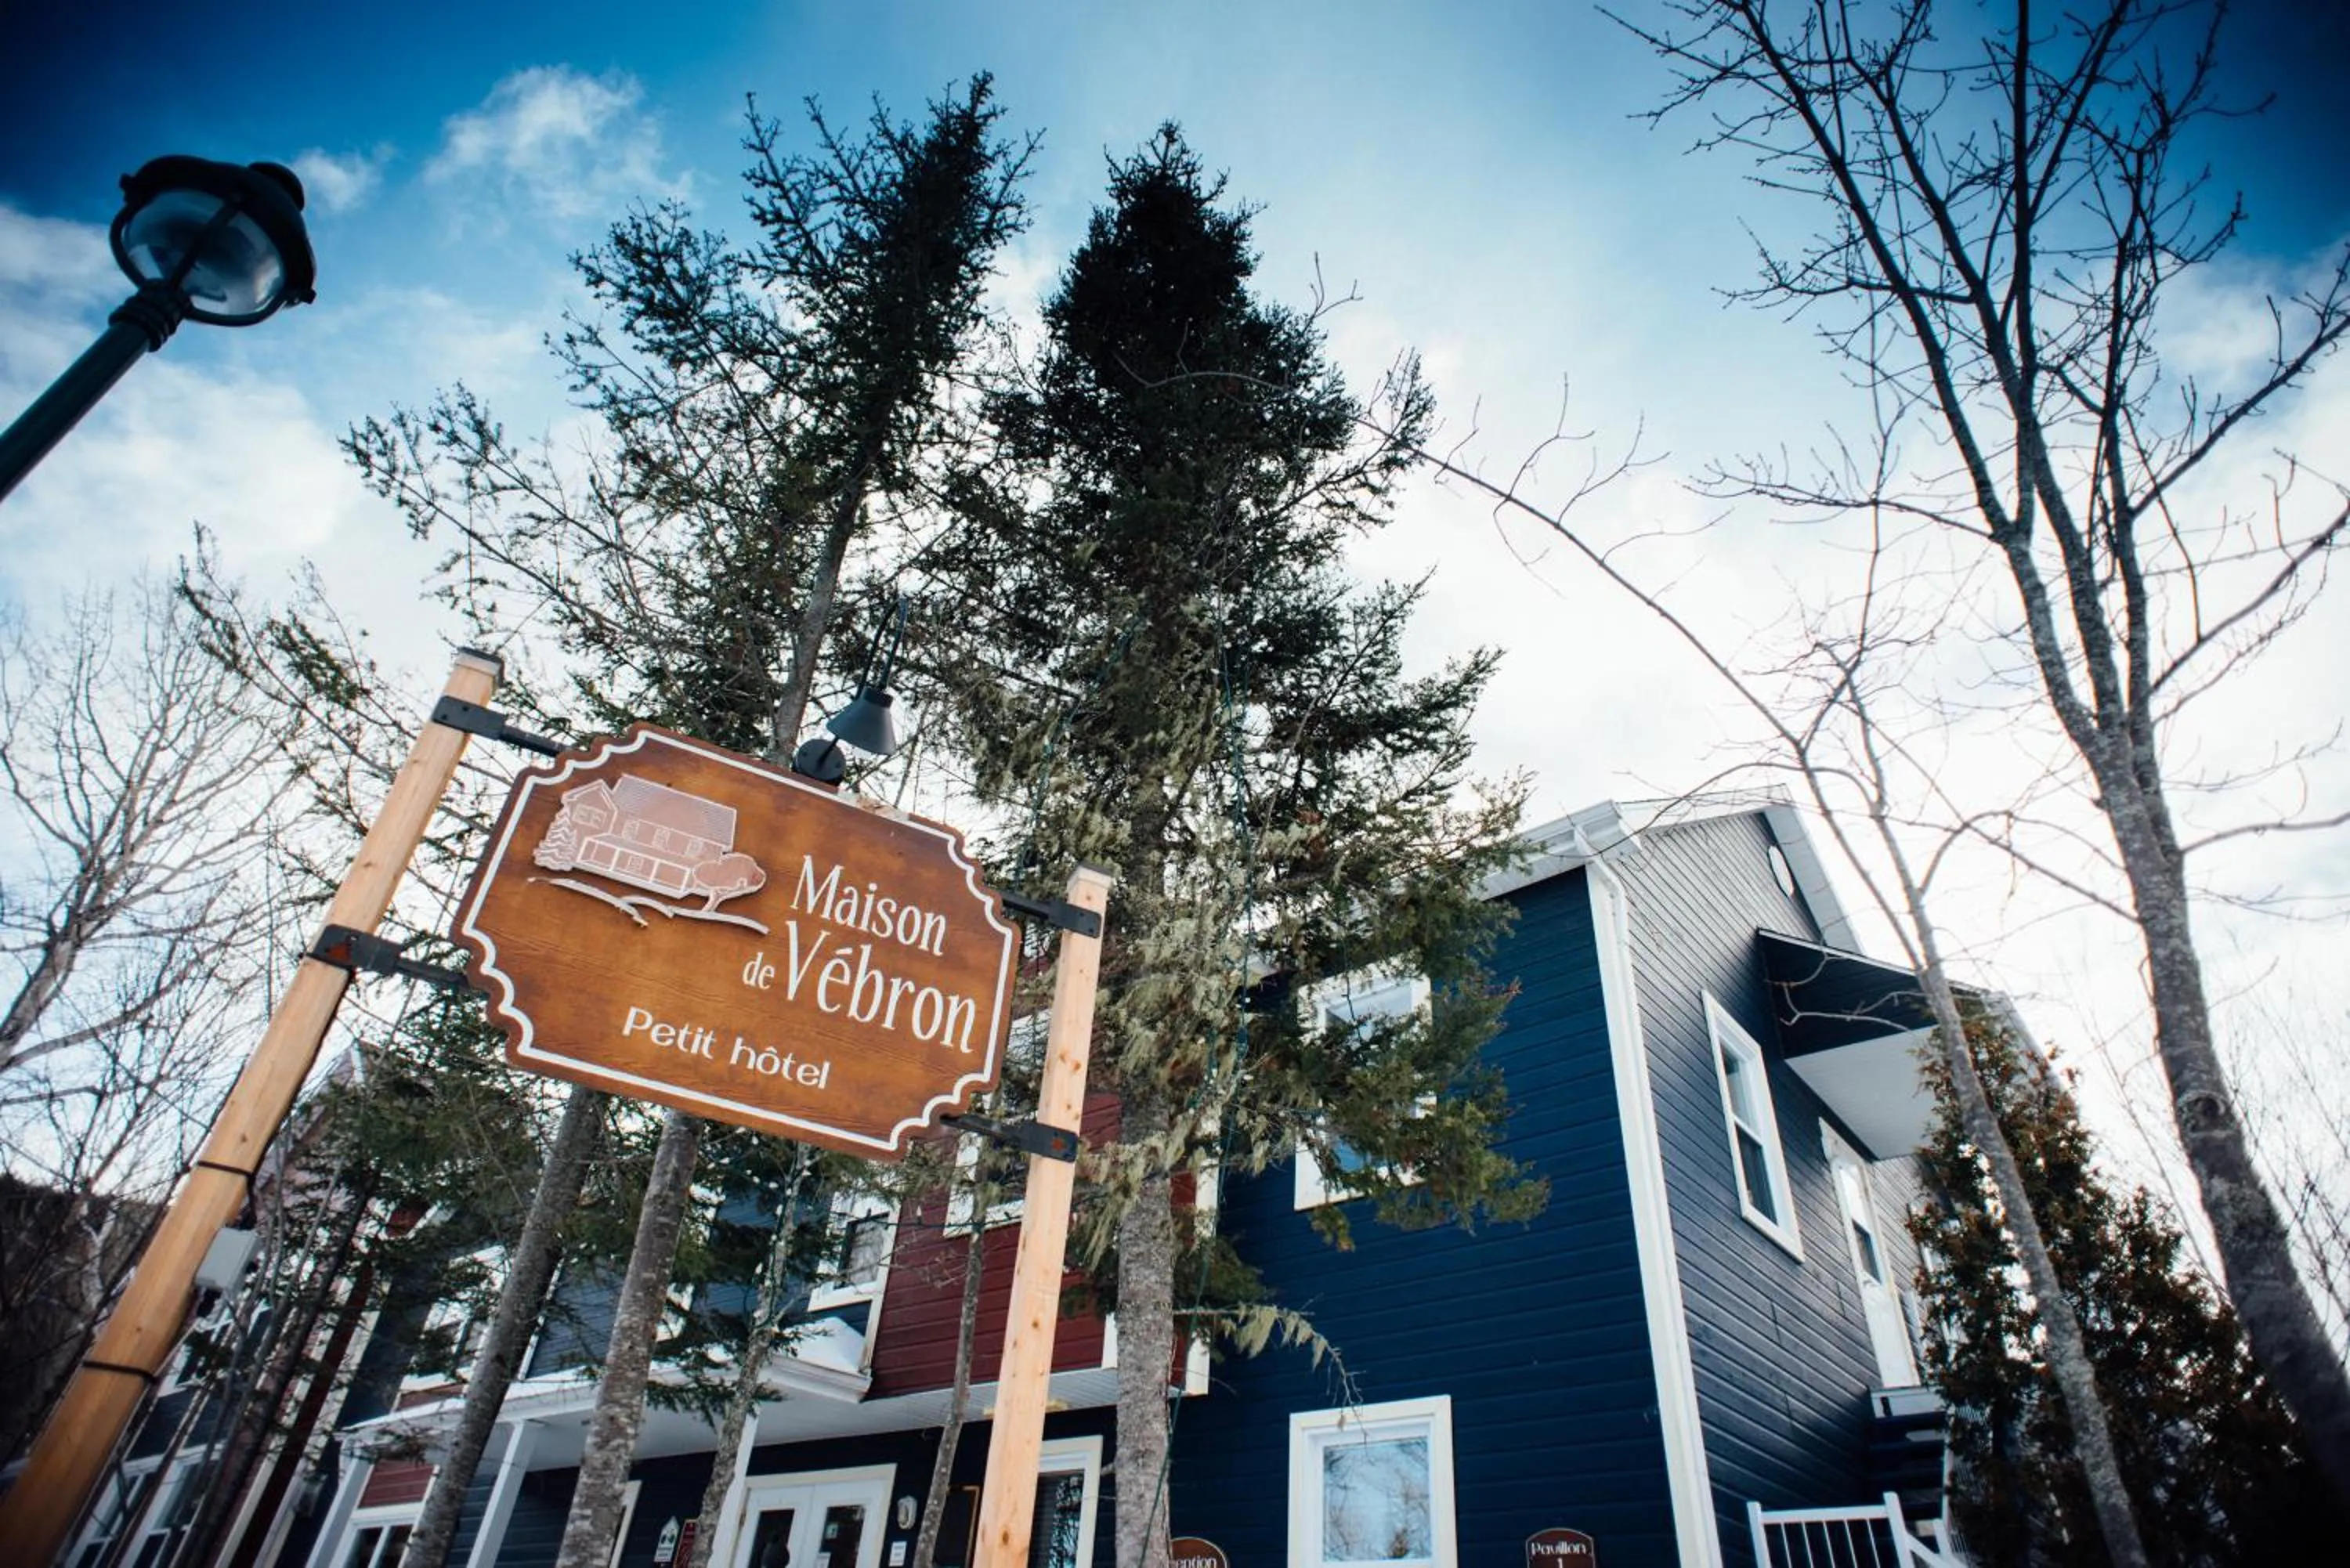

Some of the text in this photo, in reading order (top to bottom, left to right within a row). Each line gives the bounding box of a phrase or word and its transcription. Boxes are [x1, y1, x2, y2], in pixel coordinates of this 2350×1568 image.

[790, 854, 947, 955] Maison
[743, 920, 976, 1053] de Vébron
[622, 1006, 830, 1089] Petit hôtel
